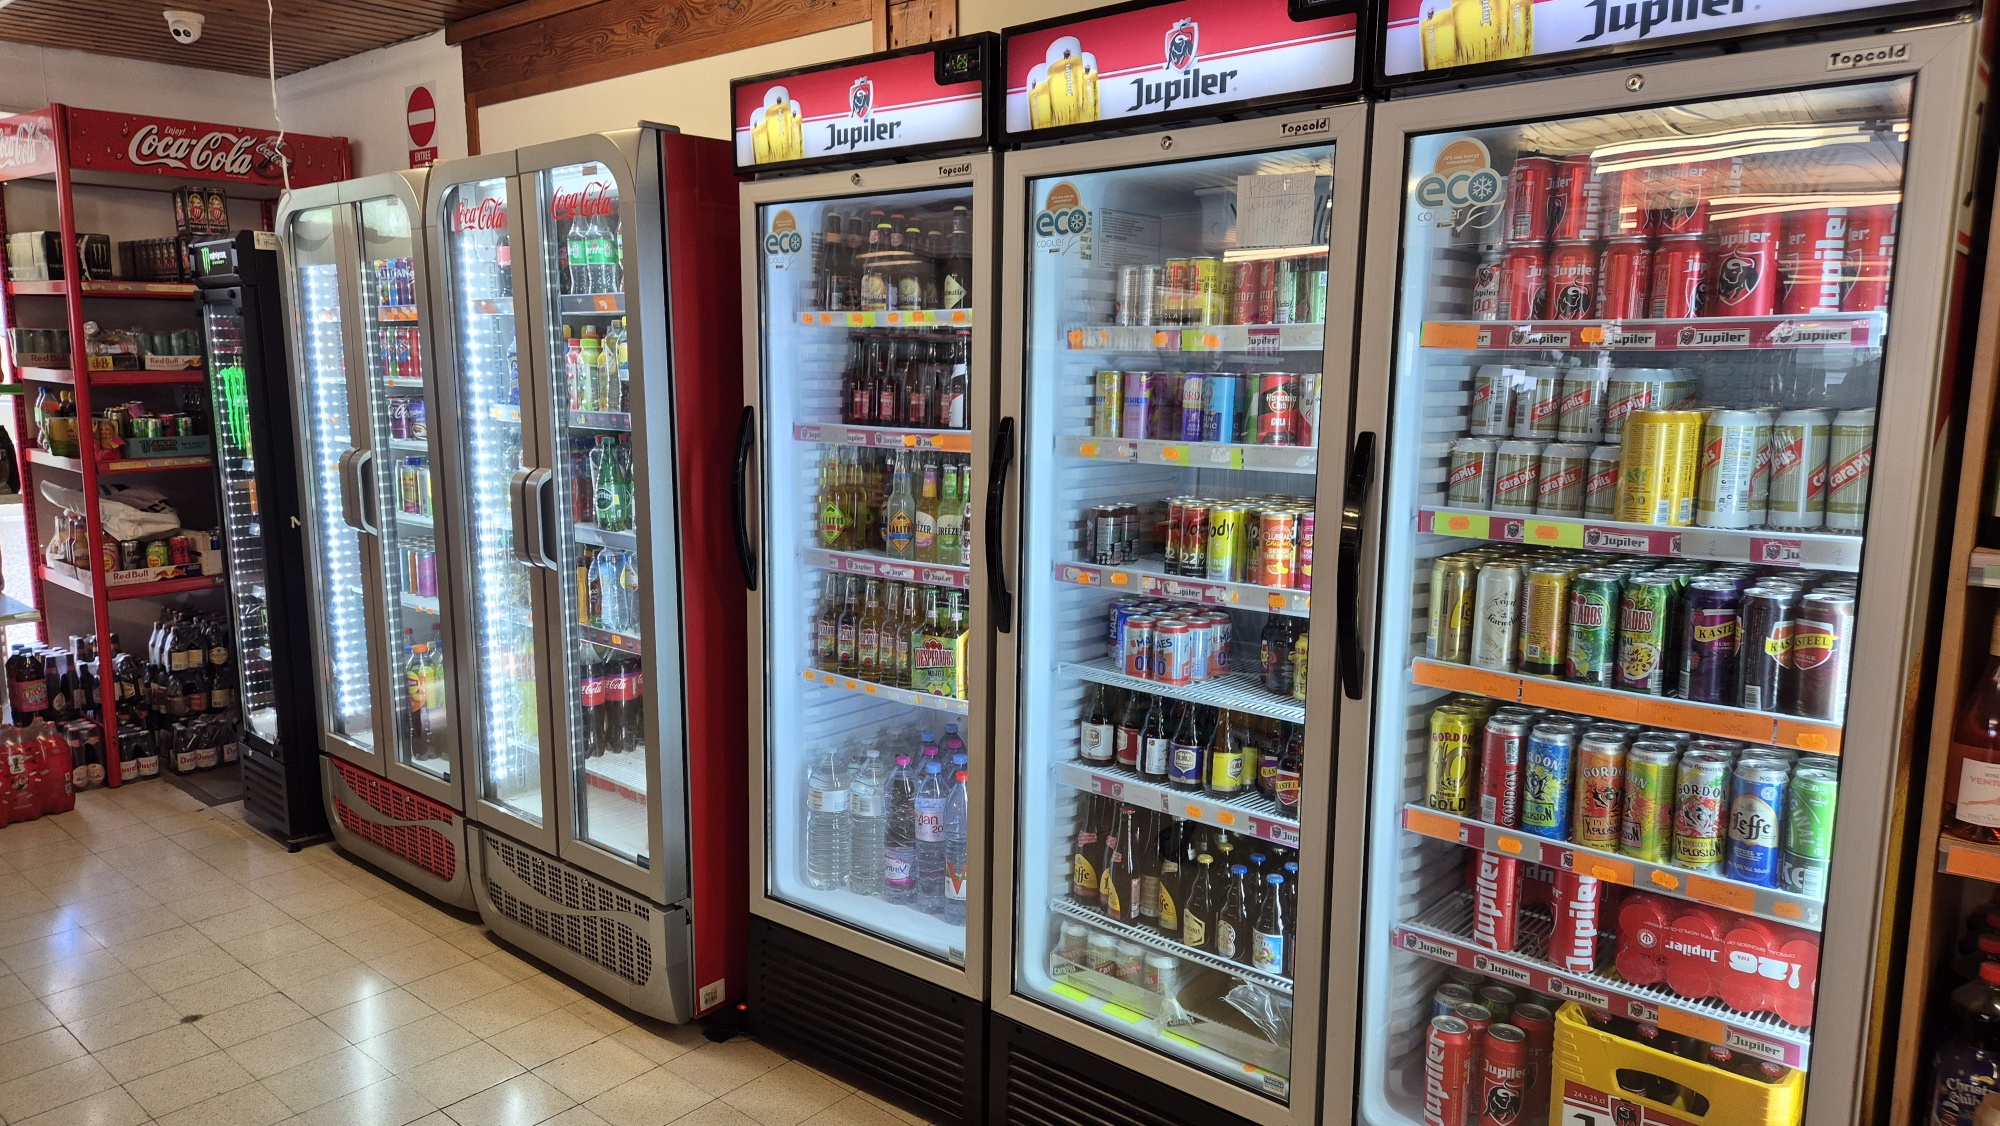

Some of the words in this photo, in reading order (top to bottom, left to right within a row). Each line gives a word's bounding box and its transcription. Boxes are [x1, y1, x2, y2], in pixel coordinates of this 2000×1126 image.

[1829, 45, 1907, 69] Topcold
[1126, 69, 1238, 112] Jupiler
[164, 125, 187, 136] Enjoy!
[823, 118, 902, 150] Jupiler
[1281, 119, 1327, 136] Topcold
[128, 124, 257, 175] Coca-Cola
[938, 164, 970, 176] Topcold
[1418, 172, 1498, 207] eco
[551, 180, 613, 220] Coca-Cola
[454, 197, 506, 233] Coca-Cola
[1036, 207, 1087, 236] eco
[1418, 209, 1463, 222] cooer
[765, 232, 802, 255] eco
[1037, 238, 1065, 249] cooler
[1554, 265, 1597, 277] Jupiler
[1247, 336, 1278, 346] Jupiler
[1697, 331, 1746, 345] Jupiler
[1794, 330, 1848, 343] Jupiler
[1559, 392, 1585, 413] raPils
[807, 431, 820, 440] Jupi
[847, 433, 864, 442] upiler
[1450, 464, 1476, 484] araPils
[1500, 468, 1536, 490] CaraPils
[1540, 472, 1577, 494] CaraPils
[1587, 475, 1611, 494] raPils
[1209, 518, 1235, 540] ody
[1602, 534, 1645, 548] Jupiler
[113, 572, 131, 580] Red
[131, 570, 148, 579] Bull
[1110, 608, 1118, 639] MAES
[1570, 604, 1603, 626] RADOS
[1621, 610, 1653, 632] RADOS
[1699, 622, 1736, 639] KASTE
[1156, 638, 1173, 649] AES
[1794, 636, 1830, 647] STEEL
[915, 648, 954, 668] DESPERADOS
[23, 685, 46, 699] Oasis
[120, 764, 137, 774] uvel
[1527, 751, 1560, 771] RDON
[1277, 780, 1299, 789] ASTEE
[1429, 793, 1467, 812] GOLD
[1502, 770, 1519, 827] GORDON
[1586, 818, 1621, 836] XPLOSI
[1732, 812, 1772, 841] Leffe
[1789, 798, 1815, 845] GINAL
[1474, 850, 1503, 951] Jupiler
[1417, 941, 1454, 958] Jupiler
[1664, 940, 1721, 963] Jupiler
[1489, 963, 1527, 980] Jupiler
[1564, 986, 1605, 1004] Jupiler
[1733, 1035, 1781, 1058] Jupiler
[1423, 1028, 1445, 1126] Jupiler
[1484, 1059, 1527, 1078] Jupiler
[1573, 1091, 1582, 1099] 24
